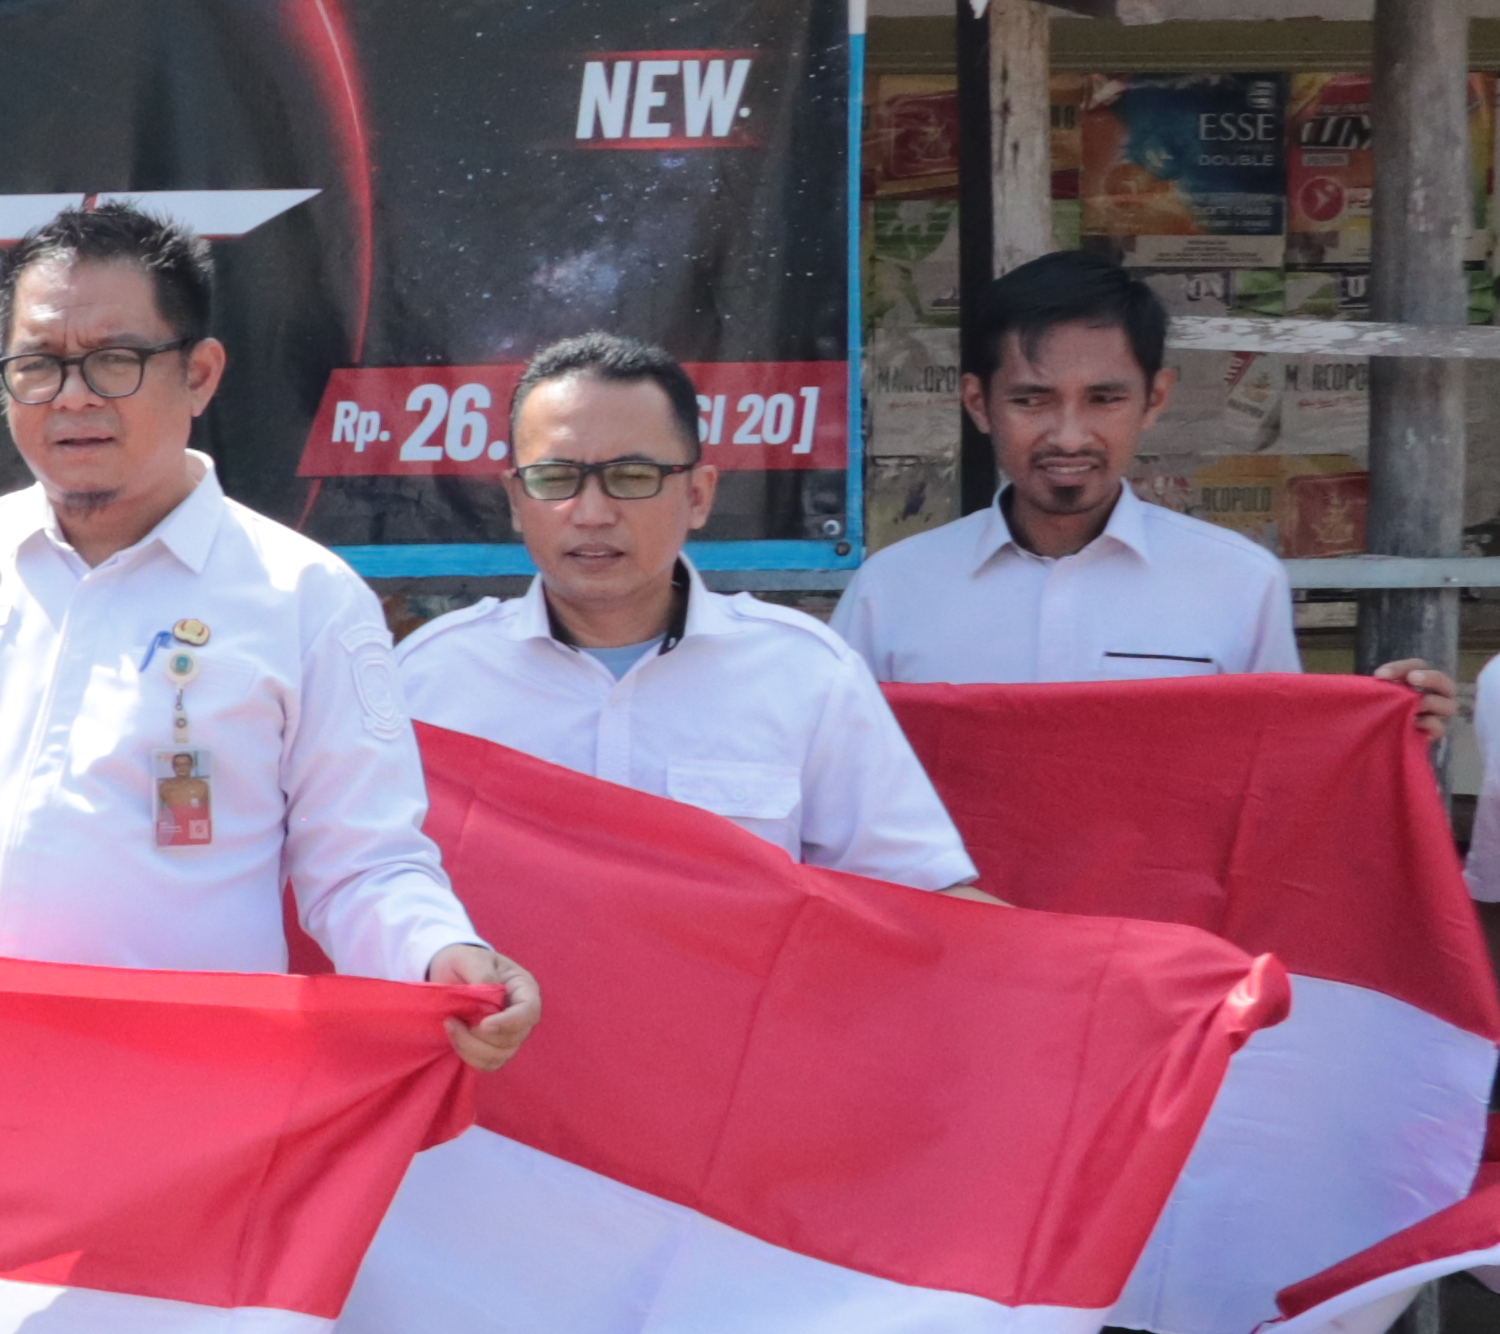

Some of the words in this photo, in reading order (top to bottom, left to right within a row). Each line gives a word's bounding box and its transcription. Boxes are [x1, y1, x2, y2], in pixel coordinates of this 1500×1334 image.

[1199, 113, 1276, 142] ESSE
[1198, 153, 1275, 167] DOUBLE
[331, 401, 391, 452] Rp.
[732, 386, 820, 455] 20]
